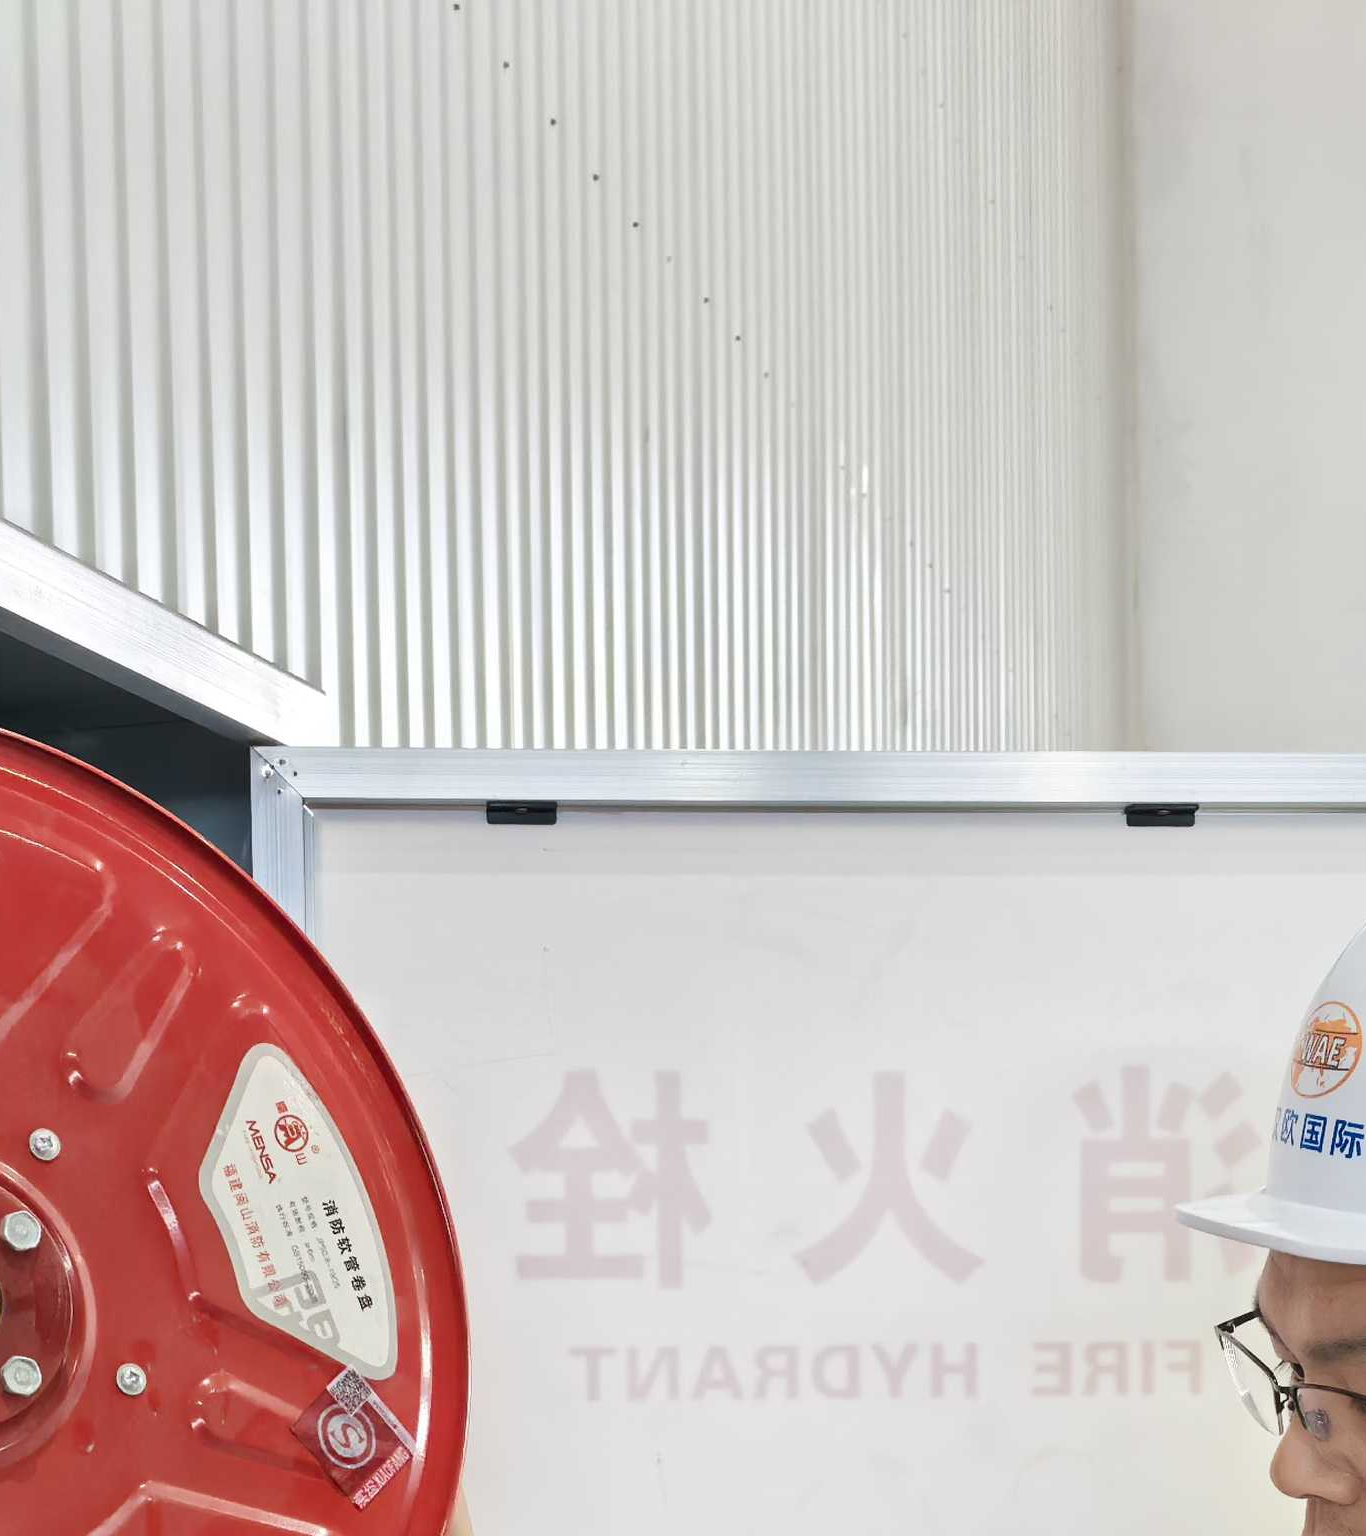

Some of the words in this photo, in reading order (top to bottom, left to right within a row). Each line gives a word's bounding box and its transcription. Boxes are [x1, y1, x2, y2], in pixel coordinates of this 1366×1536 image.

[244, 1118, 277, 1185] MENSA
[320, 1197, 374, 1313] 消防软管卷盘
